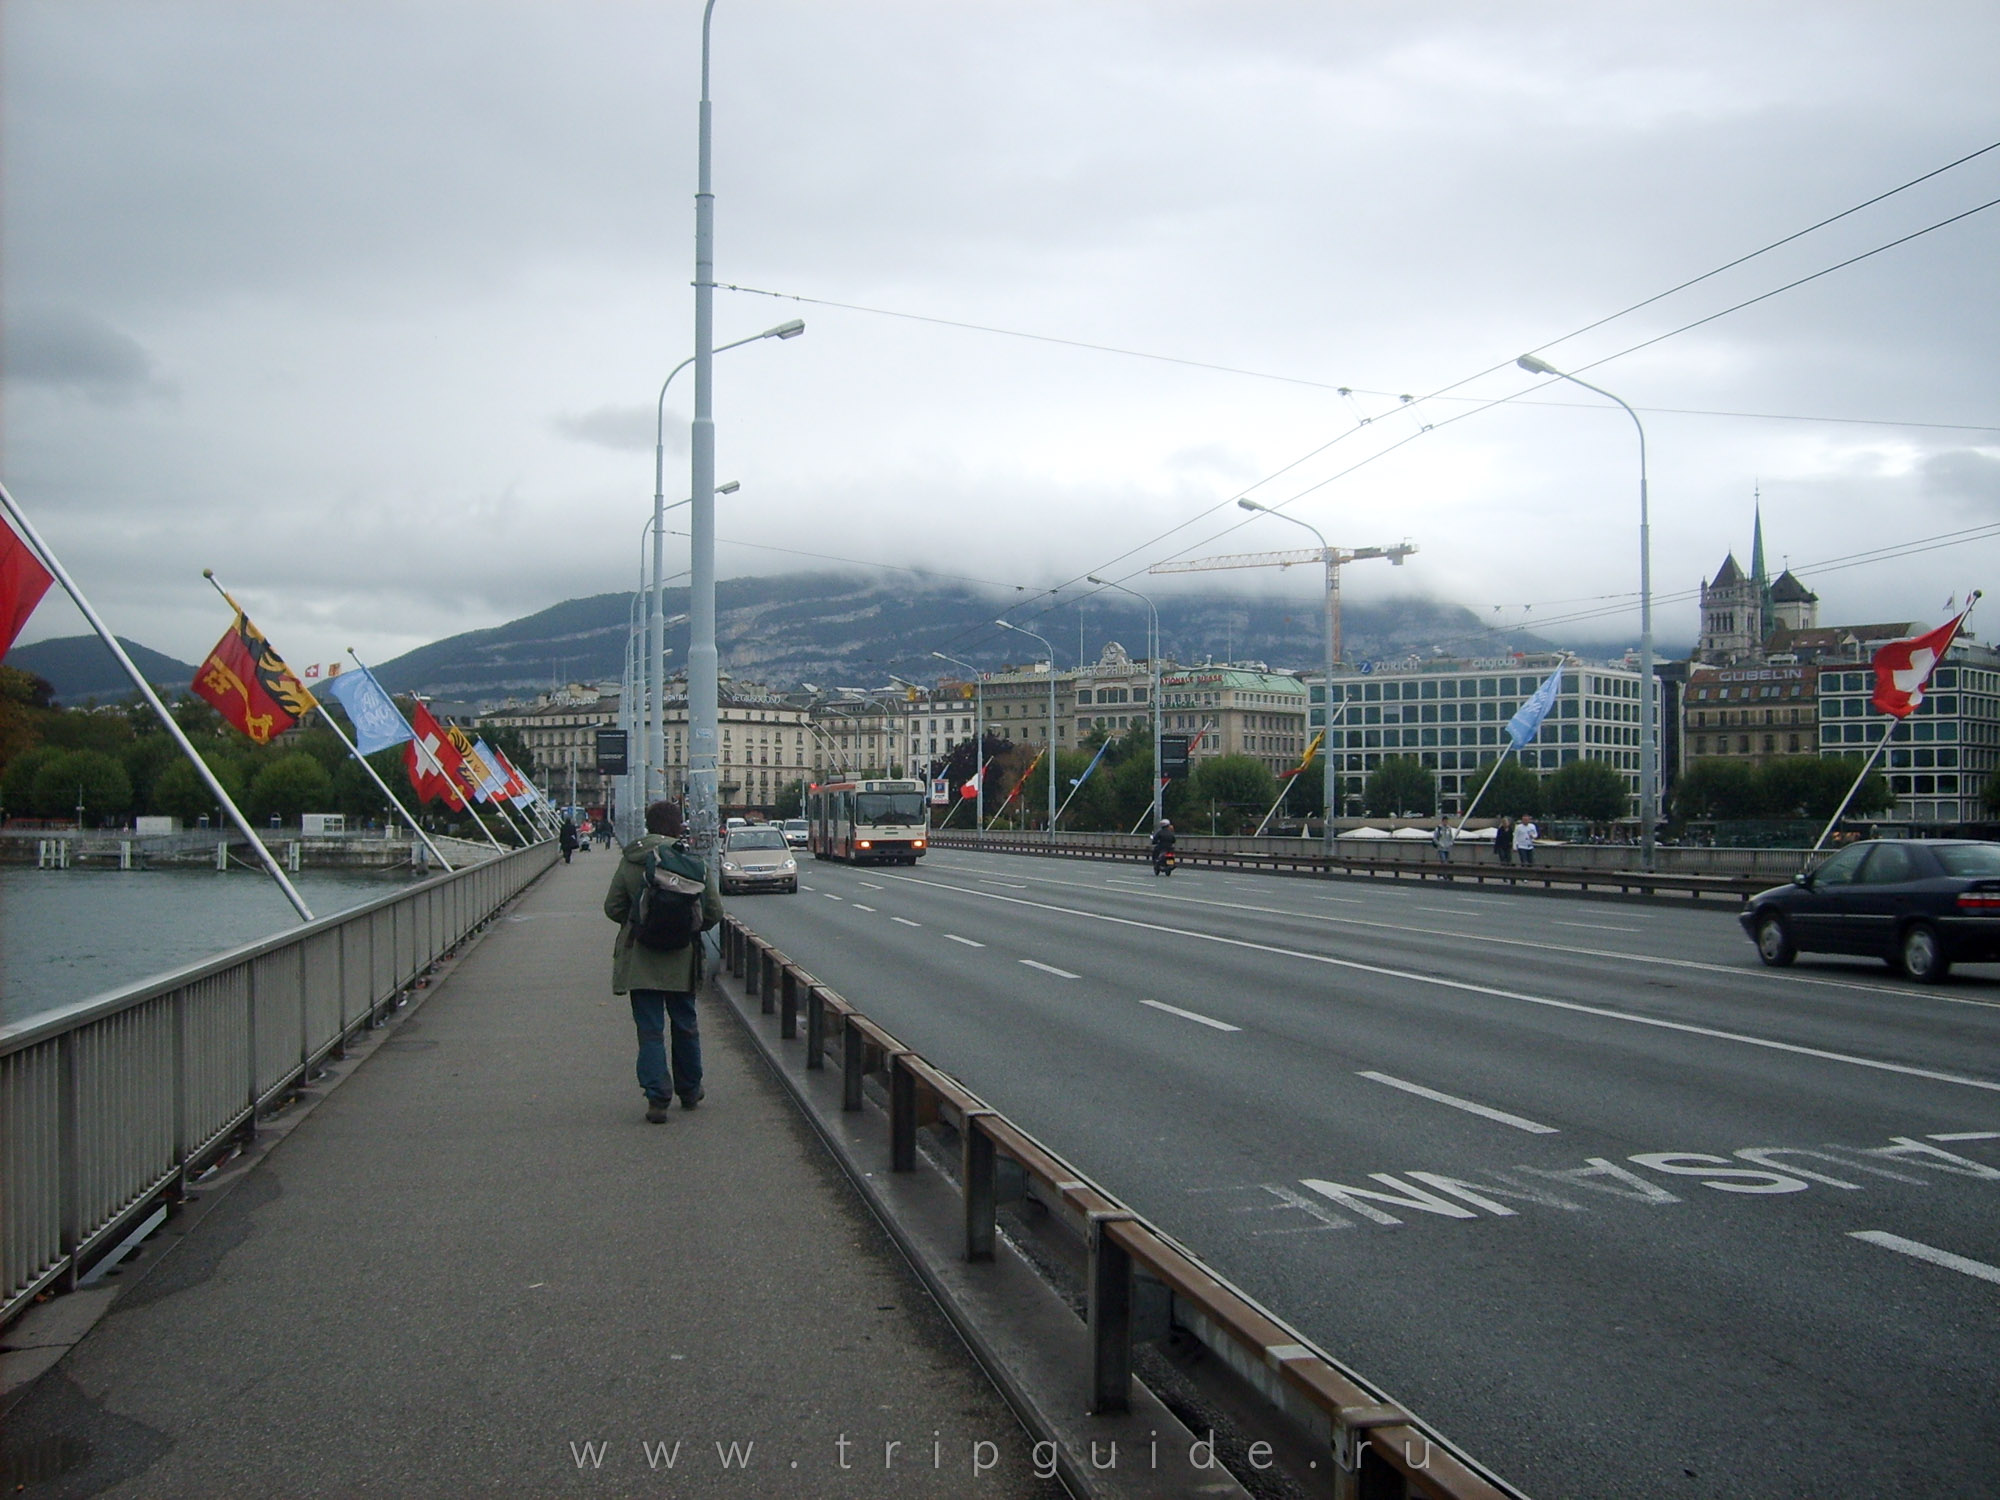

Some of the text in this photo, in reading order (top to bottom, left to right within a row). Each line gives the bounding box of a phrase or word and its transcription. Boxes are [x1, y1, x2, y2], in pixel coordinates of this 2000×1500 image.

[1105, 663, 1148, 675] PHILIPPE
[1374, 661, 1418, 672] ZURICH
[1471, 657, 1517, 669] citigroup
